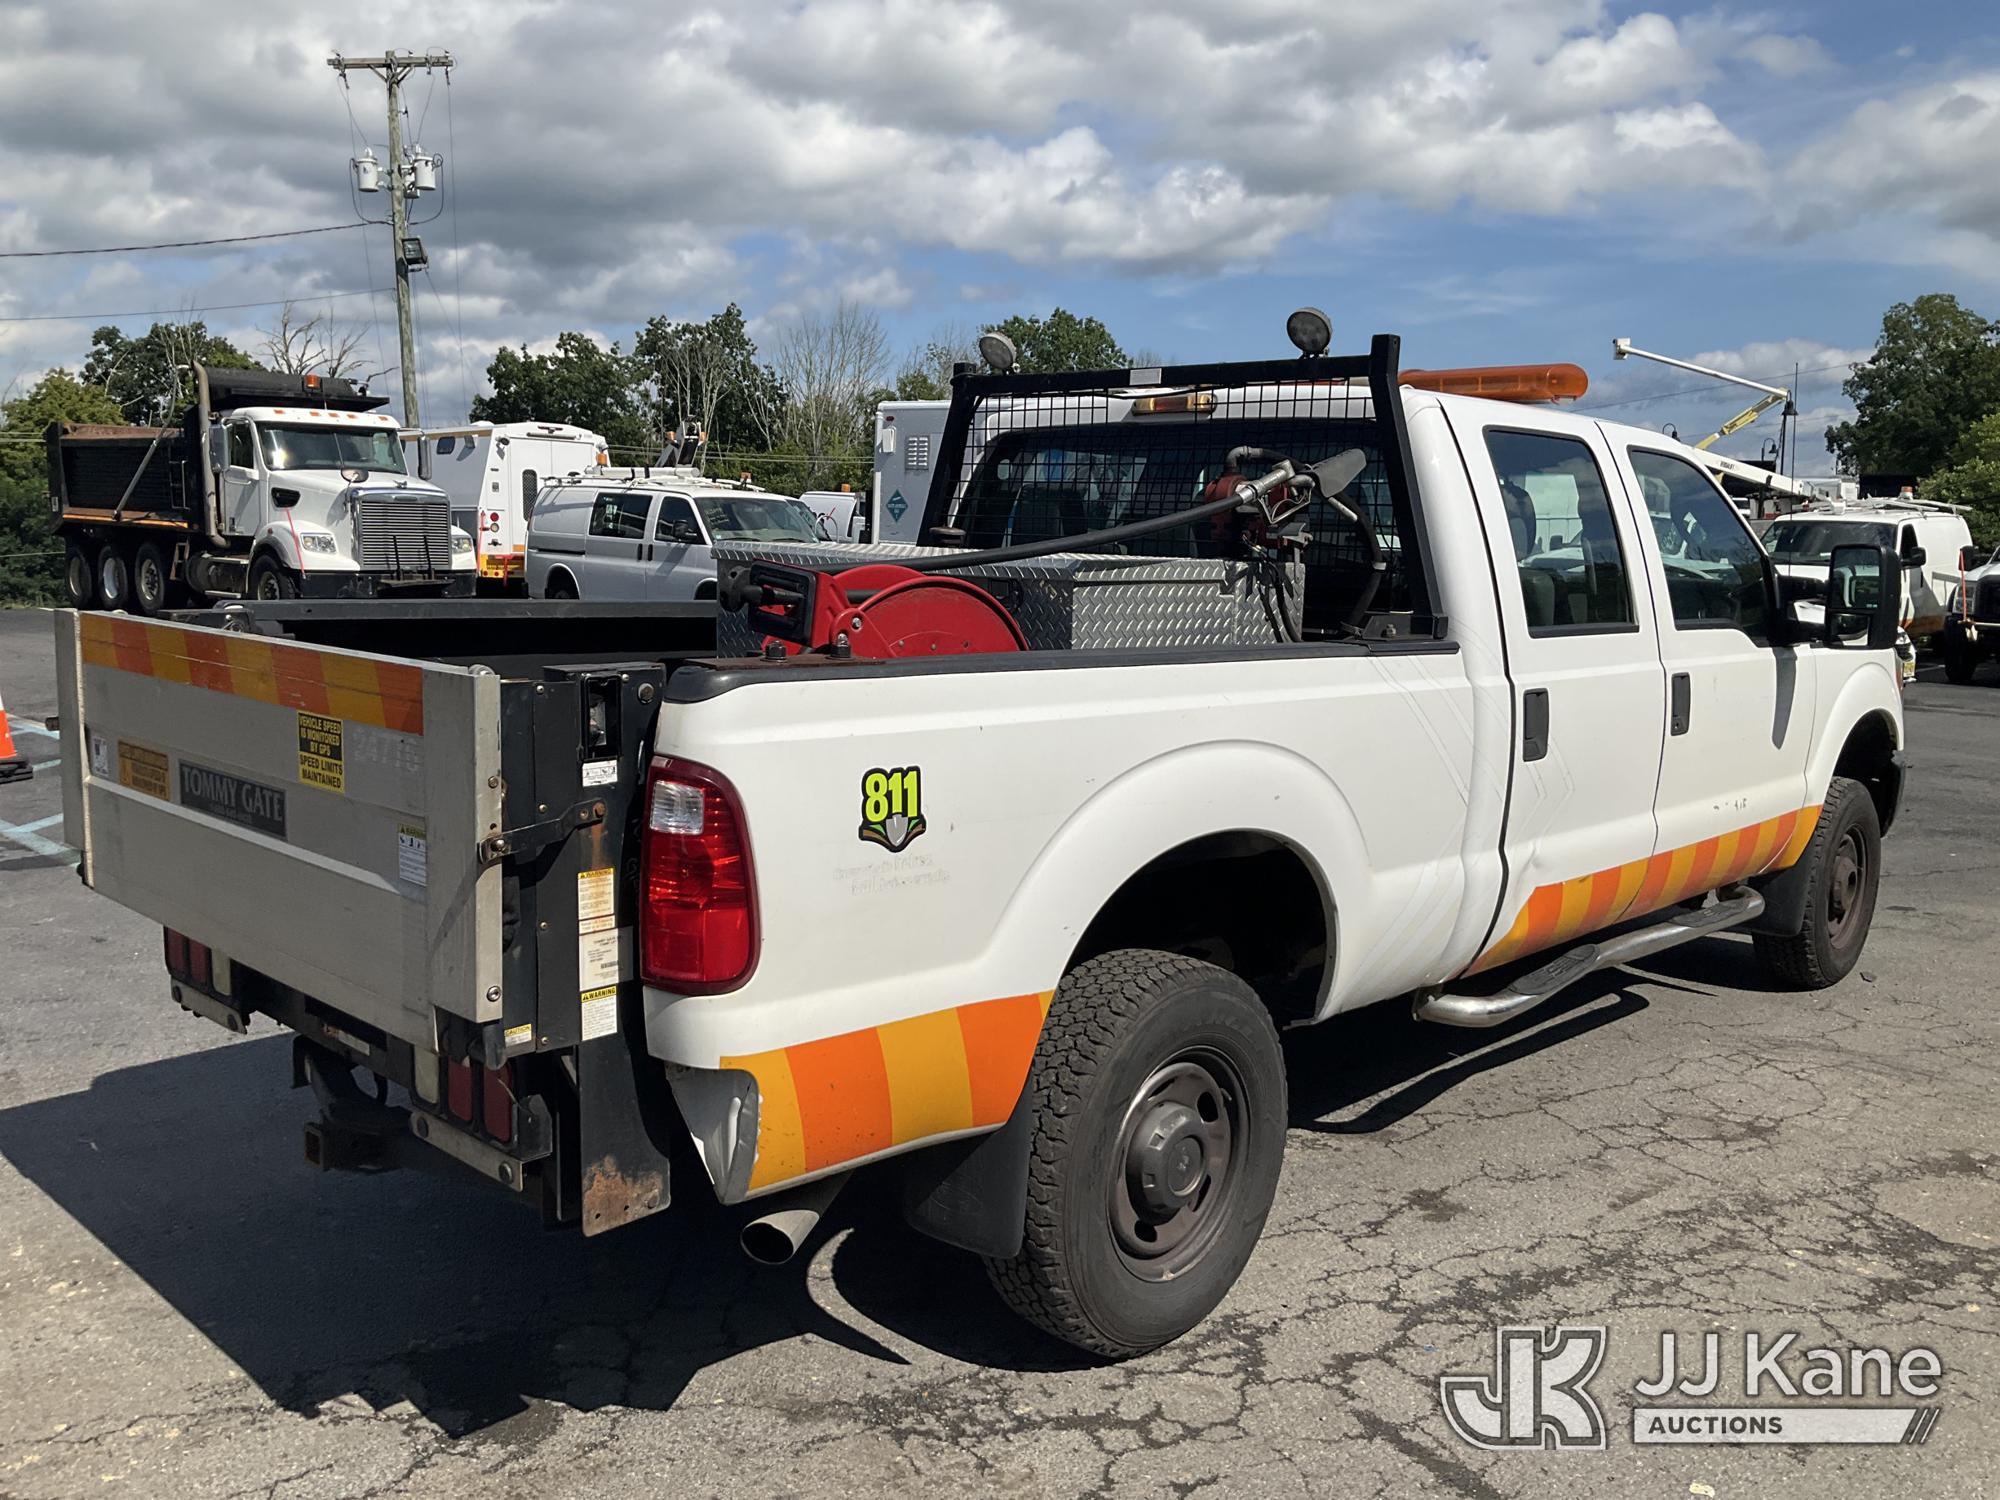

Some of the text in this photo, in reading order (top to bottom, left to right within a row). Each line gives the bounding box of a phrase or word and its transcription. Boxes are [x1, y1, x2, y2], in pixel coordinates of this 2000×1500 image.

[300, 715, 341, 734] VEHICLE SPEED
[300, 728, 340, 746] IS MONITORED
[310, 741, 331, 756] BY GPS
[300, 754, 343, 776] SPEED LIMITS
[302, 767, 341, 789] MAINTAINED
[182, 767, 238, 807] TOMMY
[241, 783, 283, 822] GATE
[864, 769, 919, 823] 811
[588, 987, 616, 1000] WARNING
